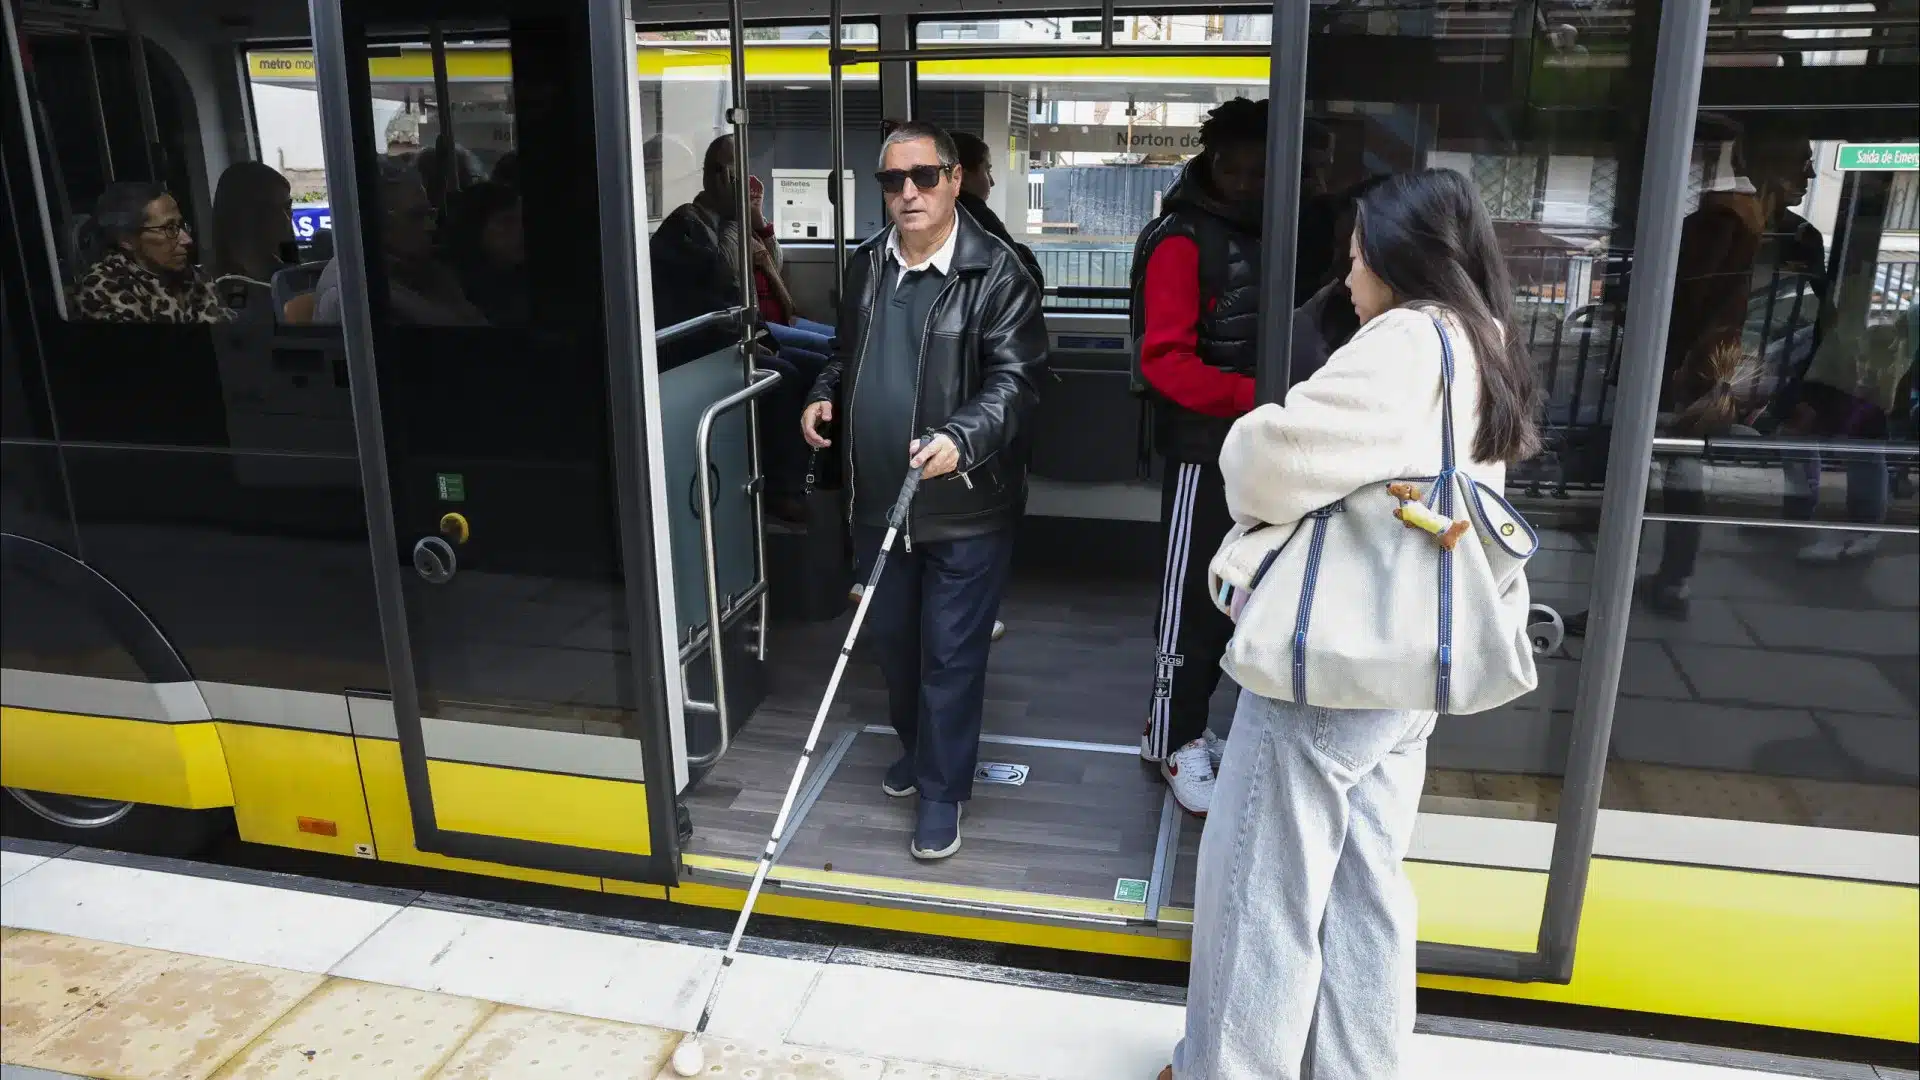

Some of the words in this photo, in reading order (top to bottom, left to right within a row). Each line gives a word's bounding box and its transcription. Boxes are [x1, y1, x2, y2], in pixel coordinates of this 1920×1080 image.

[260, 58, 291, 69] metro
[1117, 132, 1174, 147] Norton
[1180, 132, 1200, 147] de
[1881, 149, 1893, 164] de
